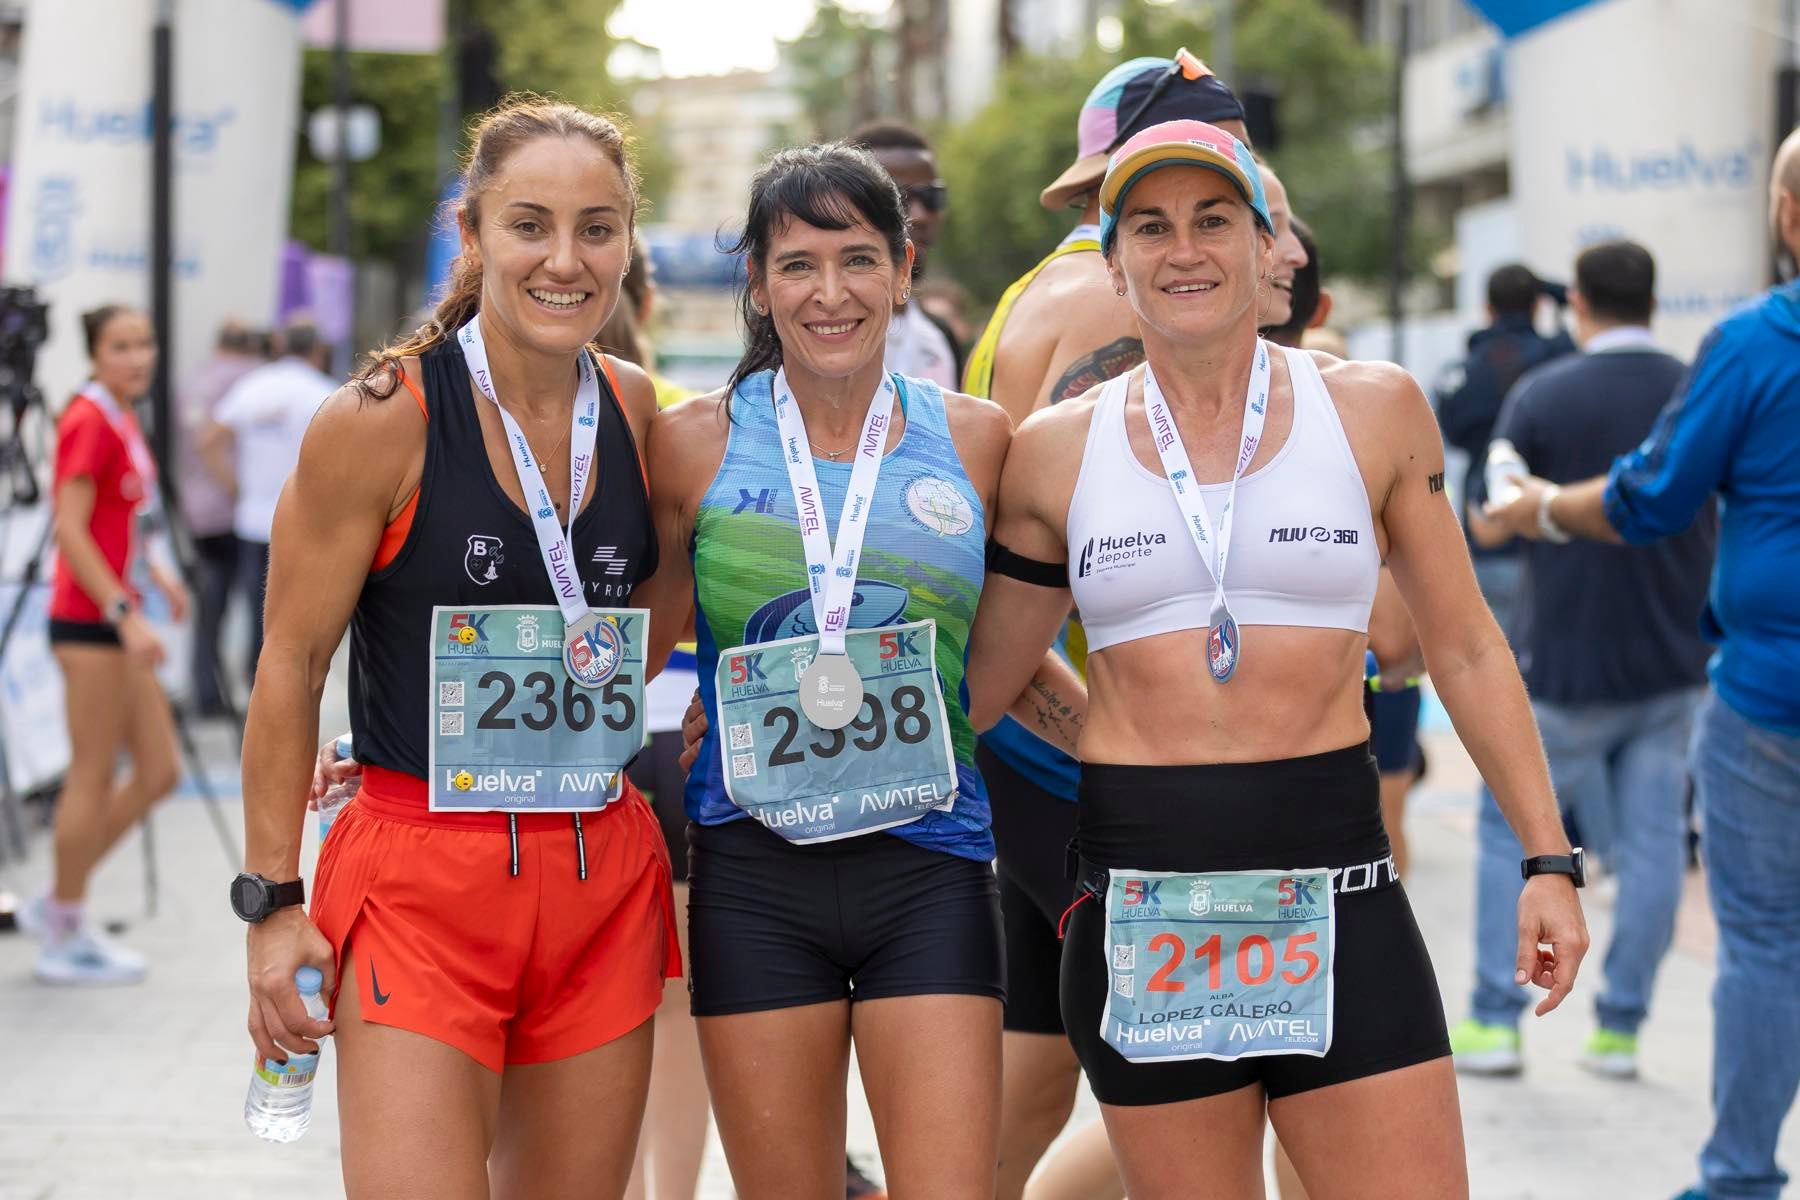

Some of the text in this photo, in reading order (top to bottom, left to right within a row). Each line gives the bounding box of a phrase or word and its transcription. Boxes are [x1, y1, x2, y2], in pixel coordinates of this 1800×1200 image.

[862, 414, 885, 458] AVATEL
[1151, 403, 1175, 451] AVATEL
[788, 437, 801, 464] Huelva
[1428, 472, 1445, 495] MU
[798, 486, 820, 536] AVATEL
[849, 494, 864, 522] Huelva
[1098, 531, 1167, 553] Huelva
[1268, 527, 1359, 545] MUV 360
[1096, 547, 1152, 565] deporte
[548, 541, 577, 598] AVATEL
[448, 613, 491, 642] 5K
[447, 644, 490, 655] HUELVA
[541, 639, 565, 649] HUEL
[569, 620, 614, 670] 5K
[878, 630, 921, 660] 5K
[1210, 620, 1233, 662] 5K
[582, 652, 621, 684] HUELVA
[729, 652, 768, 686] 5K
[880, 658, 922, 674] HUELVA
[476, 670, 636, 732] 2365
[731, 683, 770, 698] HUELVA
[504, 794, 536, 805] original
[859, 783, 945, 814] AVATEL
[804, 821, 836, 834] original
[1122, 879, 1163, 906] 5K
[1278, 877, 1318, 907] 5K
[1121, 906, 1161, 919] HUELVA
[1213, 903, 1254, 913] HUELVA
[1278, 907, 1318, 919] HUELVA
[1145, 931, 1321, 993] 2105
[1208, 992, 1235, 1001] ALBA
[1138, 1000, 1293, 1025] LOPEZ CALERO
[1116, 1019, 1319, 1044] Huelva AVATEL
[1283, 1035, 1319, 1044] TELECOM
[1171, 1041, 1203, 1052] original
